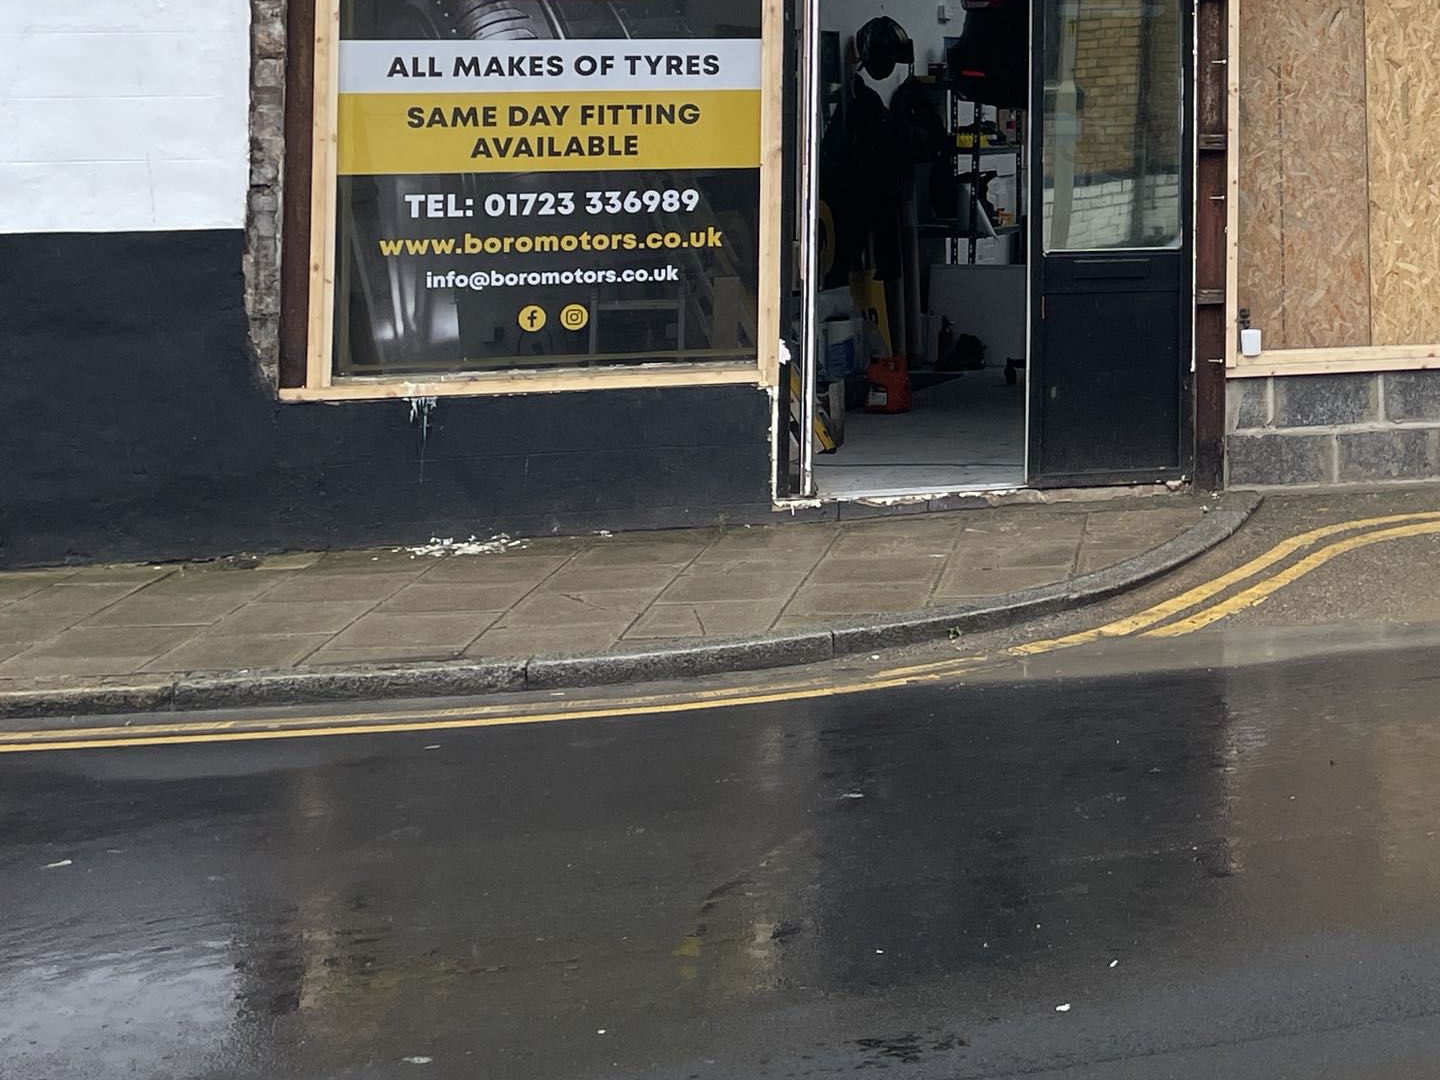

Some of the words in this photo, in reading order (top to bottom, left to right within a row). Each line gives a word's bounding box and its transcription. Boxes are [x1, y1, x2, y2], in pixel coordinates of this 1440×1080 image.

[386, 57, 443, 78] ALL
[452, 56, 563, 78] MAKES
[573, 56, 615, 77] OF
[624, 54, 721, 76] TYRES
[407, 107, 497, 129] SAME
[509, 105, 570, 127] DAY
[580, 103, 701, 126] FITTING
[470, 135, 639, 159] AVAILABLE
[404, 194, 474, 219] TEL:
[484, 192, 575, 217] 01723
[585, 189, 700, 215] 336989
[379, 226, 723, 257] www.boromotors.co.uk
[426, 264, 679, 291] info@boromotors.co.uk
